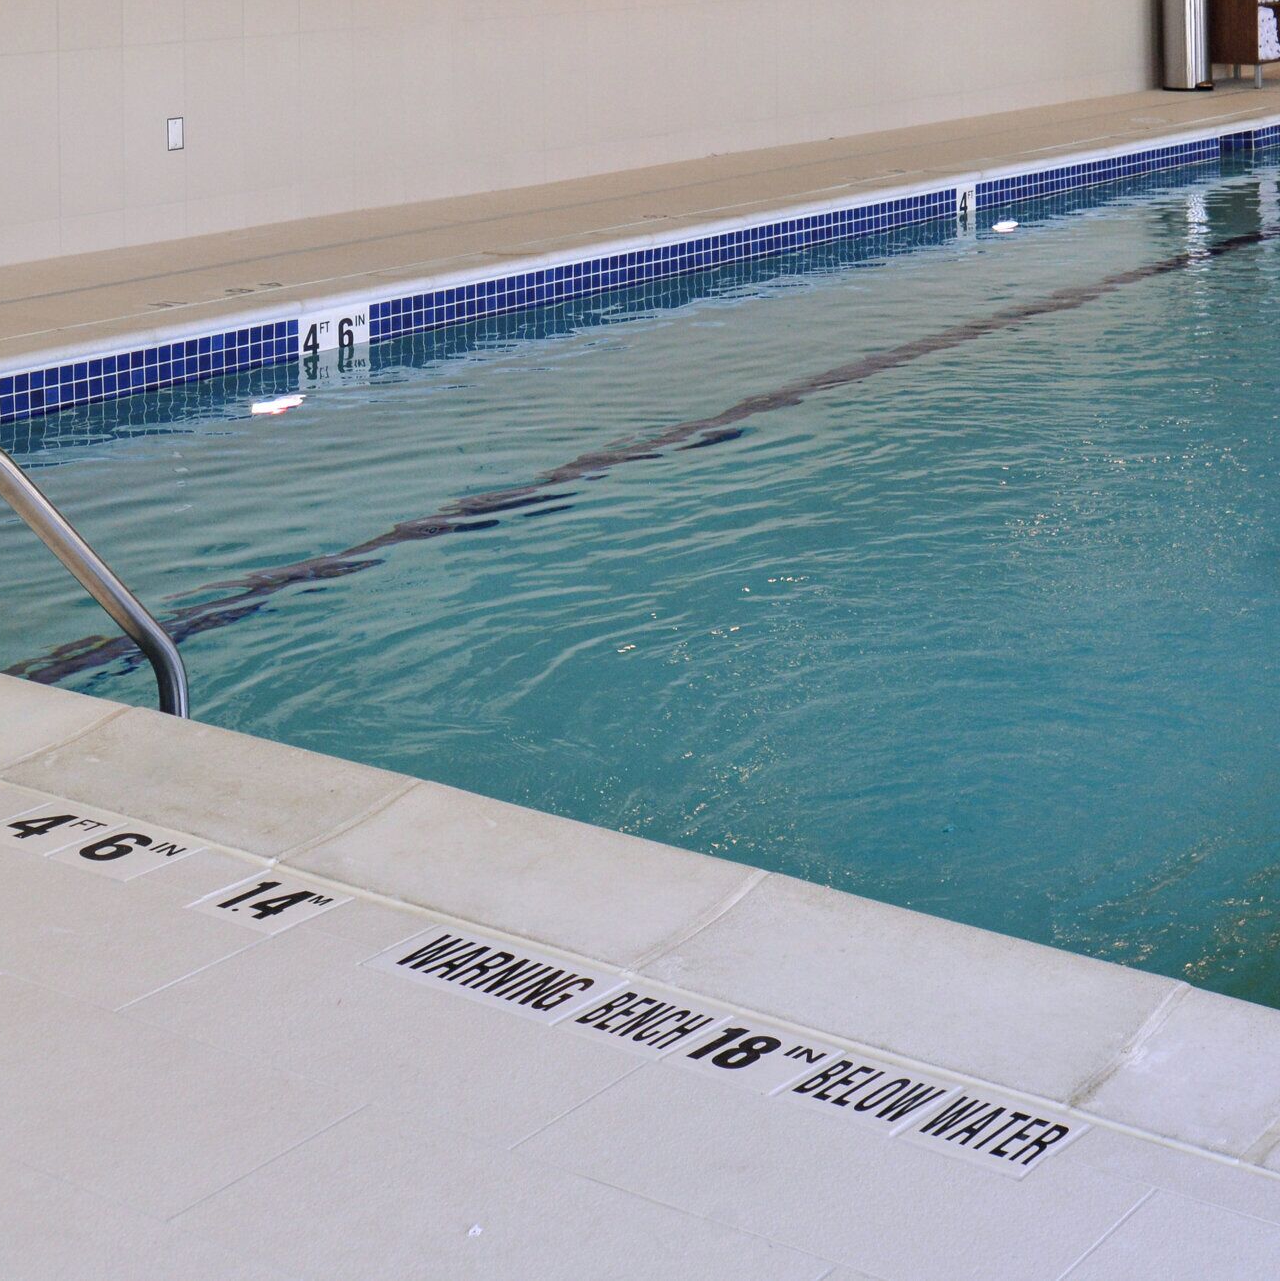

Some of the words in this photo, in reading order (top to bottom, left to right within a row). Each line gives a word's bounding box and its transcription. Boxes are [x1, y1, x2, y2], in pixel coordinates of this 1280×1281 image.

[960, 192, 968, 213] 4
[303, 323, 320, 354] 4
[320, 321, 330, 334] FT
[338, 317, 354, 348] 6
[355, 314, 365, 326] IN
[6, 814, 79, 839] 4
[69, 819, 108, 832] FT
[79, 832, 153, 861] 6
[149, 842, 187, 857] IN
[216, 881, 318, 920] 1.4
[307, 895, 334, 906] M
[395, 934, 595, 1012] WARNING
[575, 991, 715, 1050] BENCH
[686, 1026, 781, 1070] 18
[788, 1045, 825, 1065] IN
[791, 1060, 938, 1123] BELOW
[919, 1096, 1070, 1166] WATER
